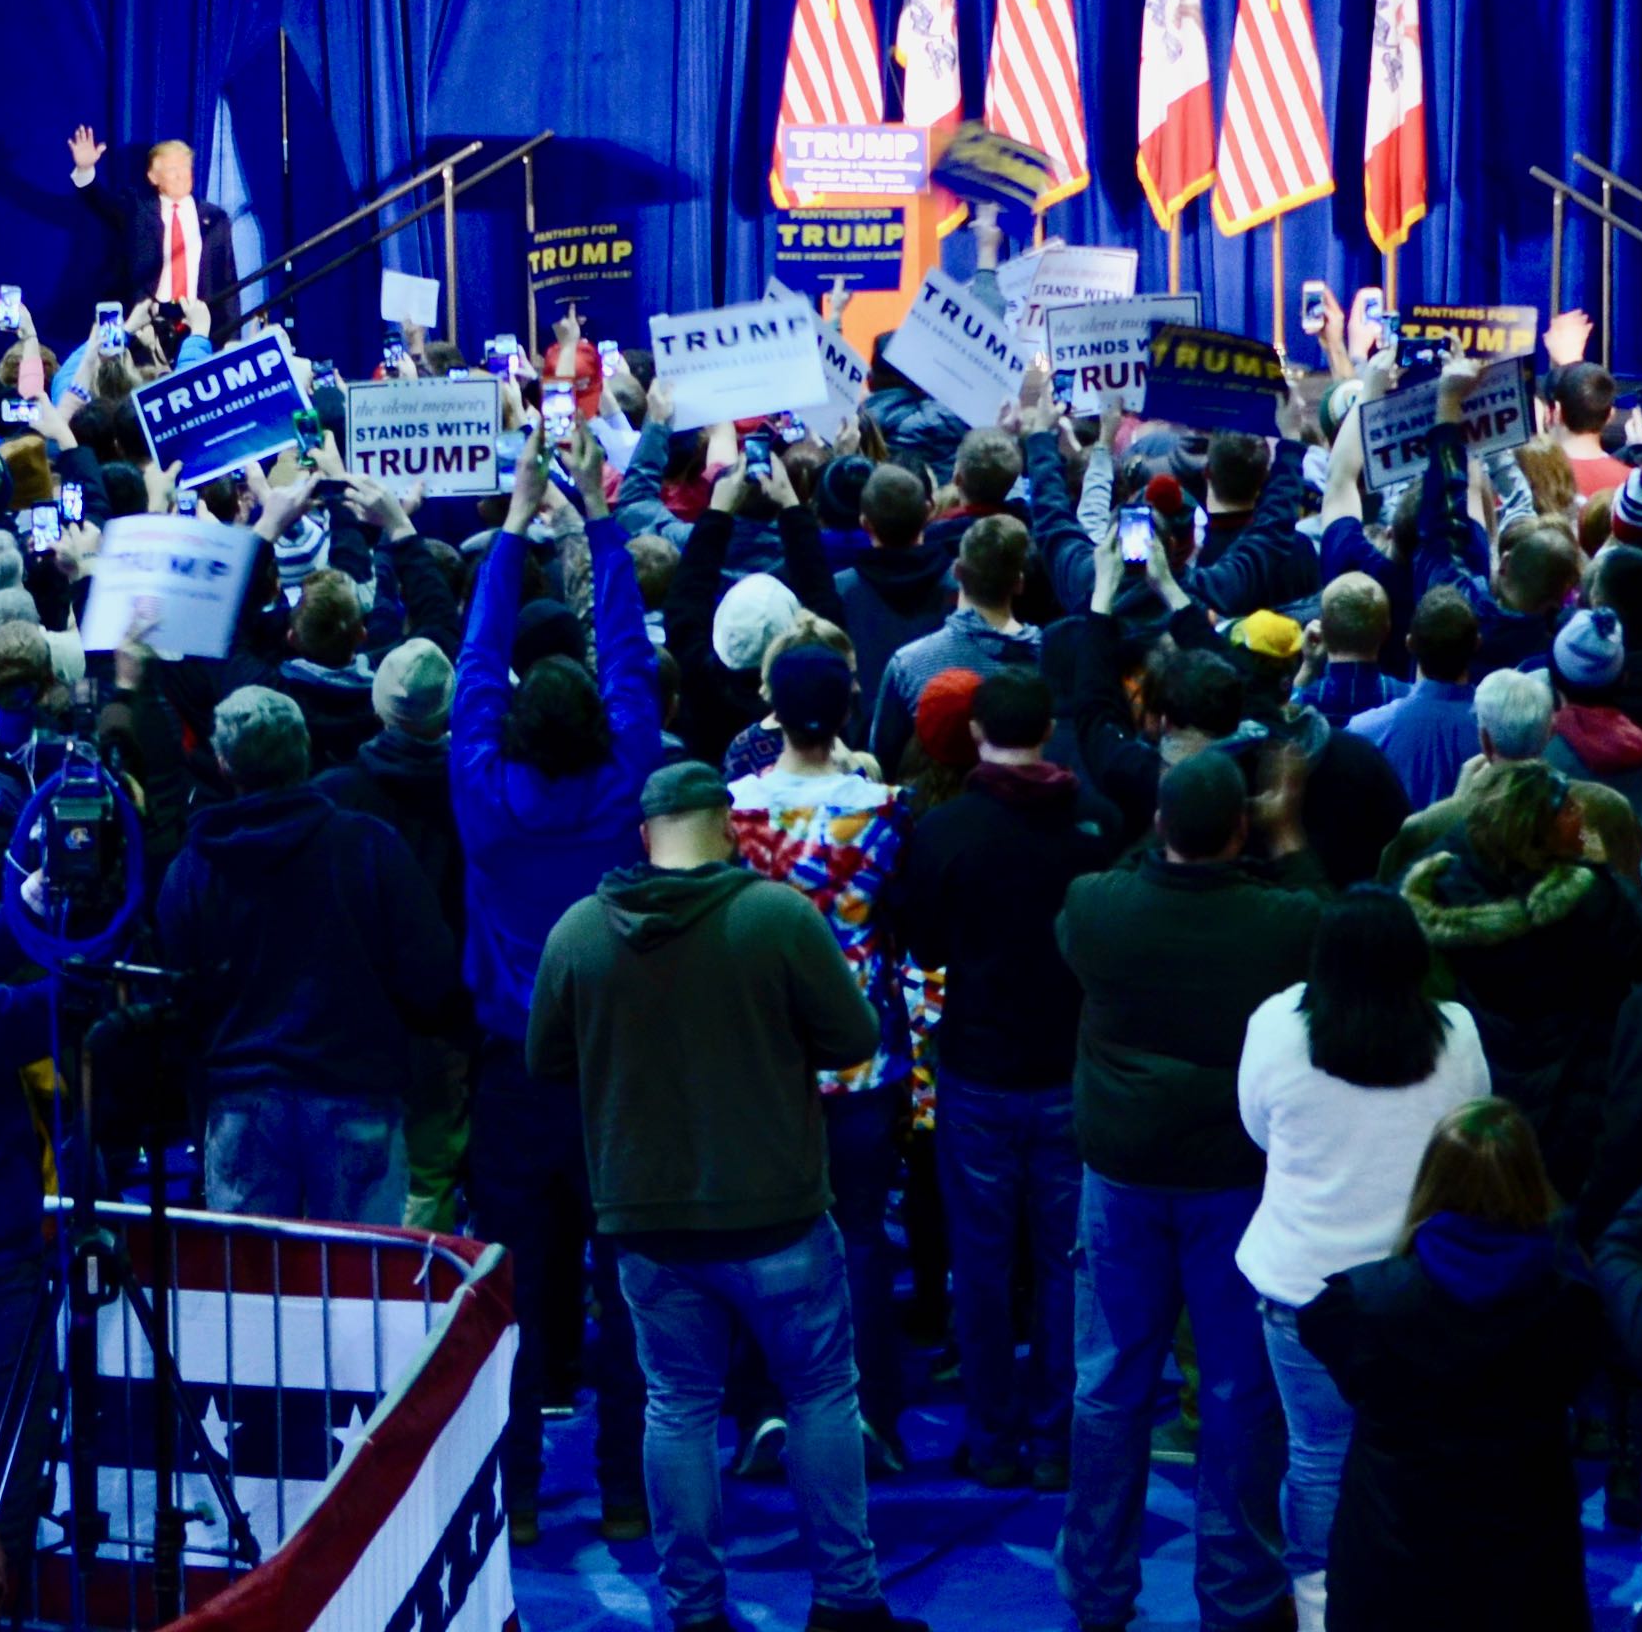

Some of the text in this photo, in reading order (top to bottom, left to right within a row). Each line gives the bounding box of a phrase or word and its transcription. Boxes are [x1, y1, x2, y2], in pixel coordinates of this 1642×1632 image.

[789, 131, 918, 160] TRUMP
[864, 210, 891, 218] FOR
[591, 223, 618, 235] FOR
[777, 224, 905, 248] TRUMP
[528, 240, 632, 274] TRUMP
[1034, 285, 1078, 297] STANDS
[924, 282, 1023, 372] TRUMP
[1413, 306, 1518, 322] PANTHERS FOR
[658, 318, 806, 355] TRUMP
[1057, 339, 1129, 360] STANDS
[143, 349, 282, 423] TRUMP
[180, 408, 224, 432] AMERICA
[224, 394, 255, 413] GREAT
[1462, 388, 1516, 413] WITH
[356, 422, 490, 441] STANDS WITH
[1372, 408, 1518, 469] TRMP
[356, 445, 491, 476] TRUMP
